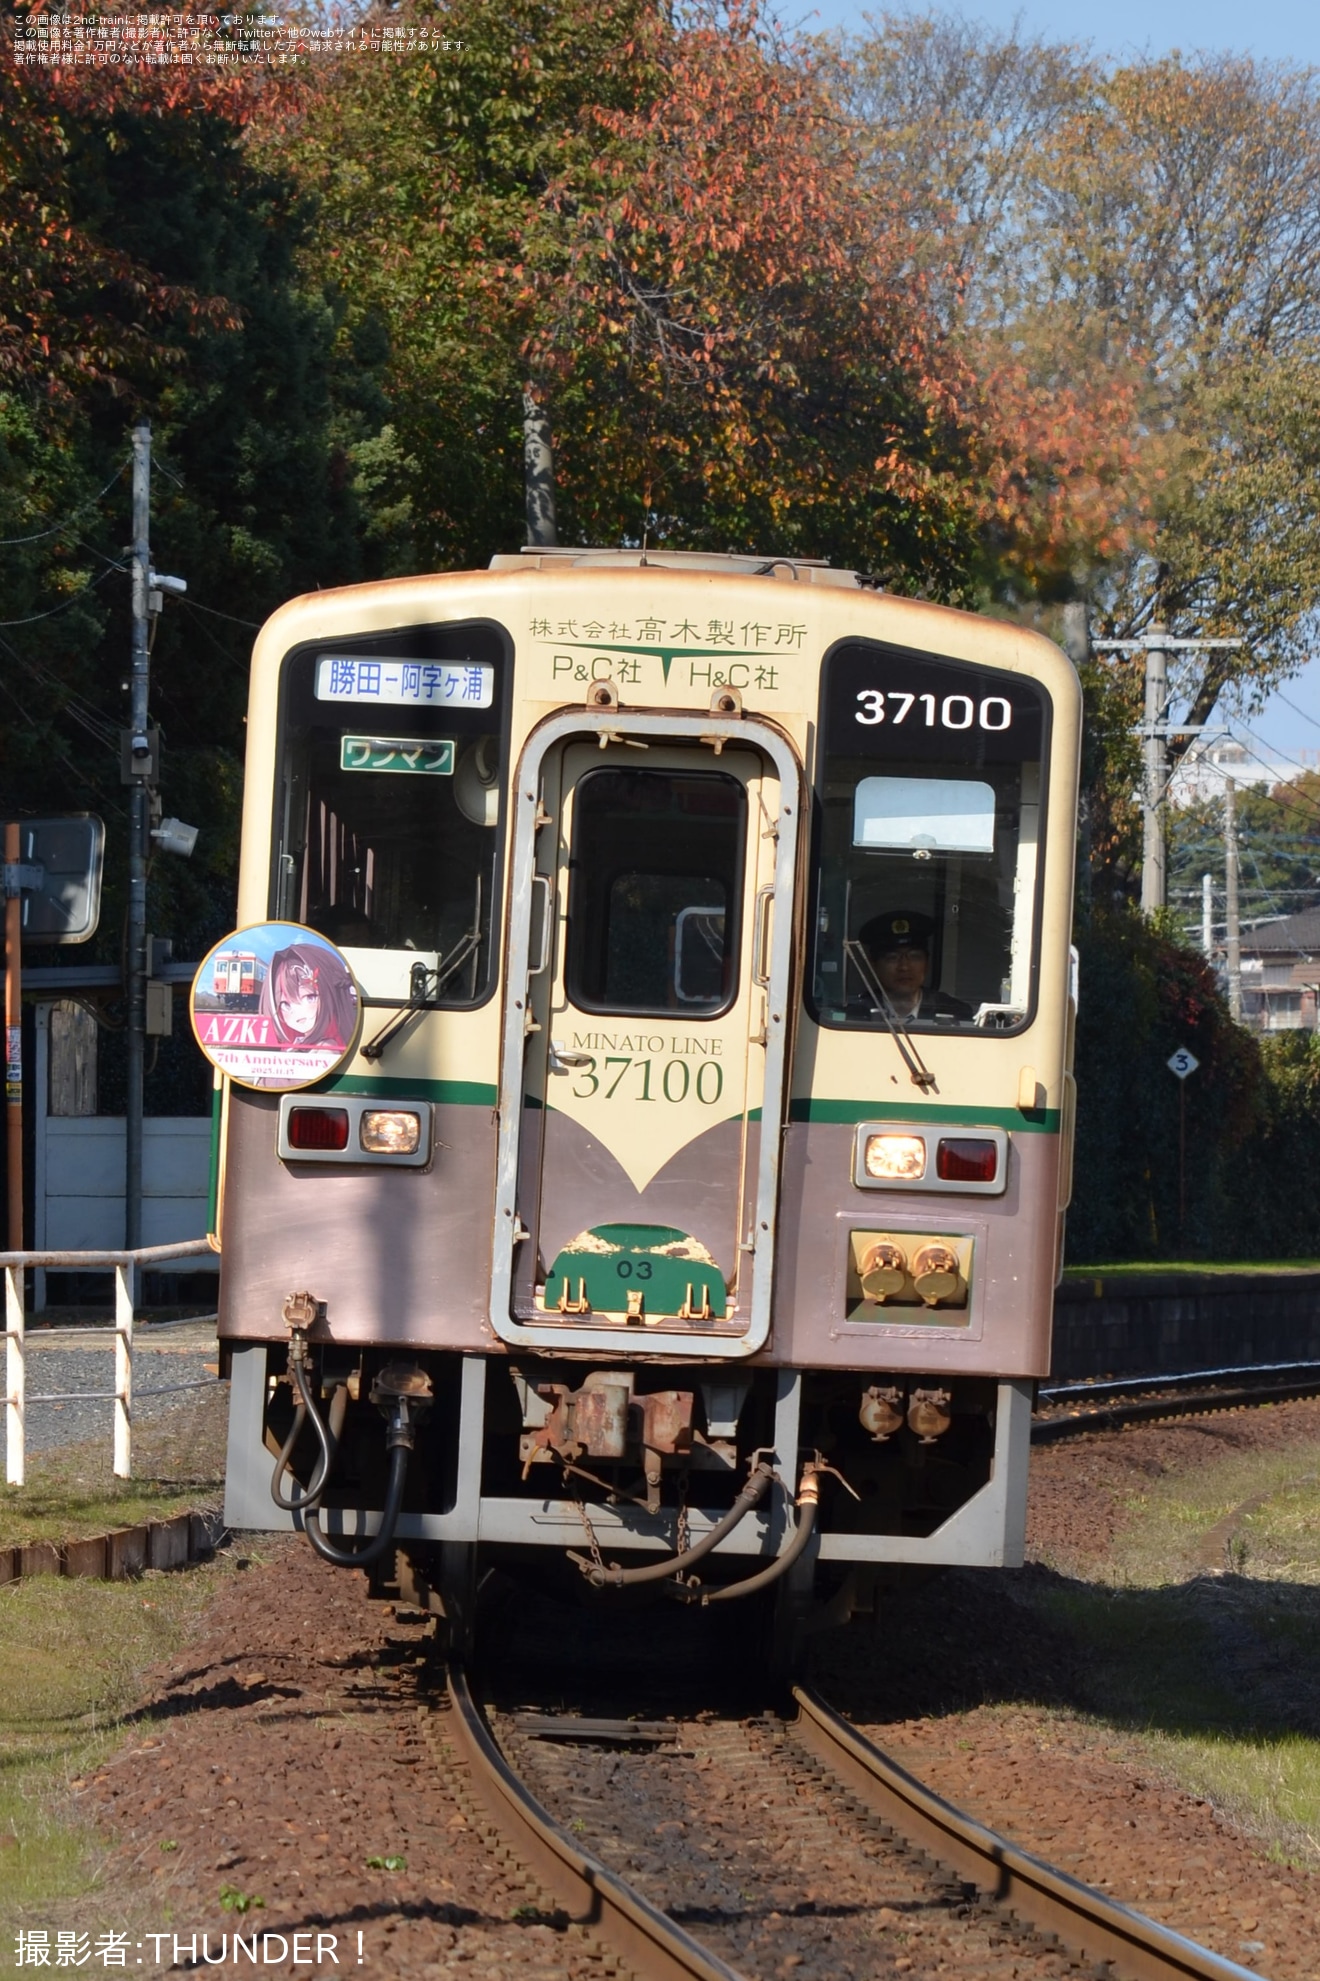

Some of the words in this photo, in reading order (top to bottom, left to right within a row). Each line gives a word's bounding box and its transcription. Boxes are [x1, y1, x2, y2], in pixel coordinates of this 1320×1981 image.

[528, 616, 808, 649] 株式会社高木製作所
[552, 655, 642, 684] P&C社
[689, 662, 780, 691] H&C社
[854, 689, 1012, 730] 37100
[203, 1017, 269, 1044] AZKi
[572, 1032, 665, 1052] MINATO
[670, 1036, 723, 1056] LINE
[217, 1052, 239, 1064] 7th
[242, 1053, 330, 1069] Anniversary
[1175, 1054, 1188, 1071] 3
[572, 1056, 723, 1105] 37100
[616, 1260, 653, 1280] 03
